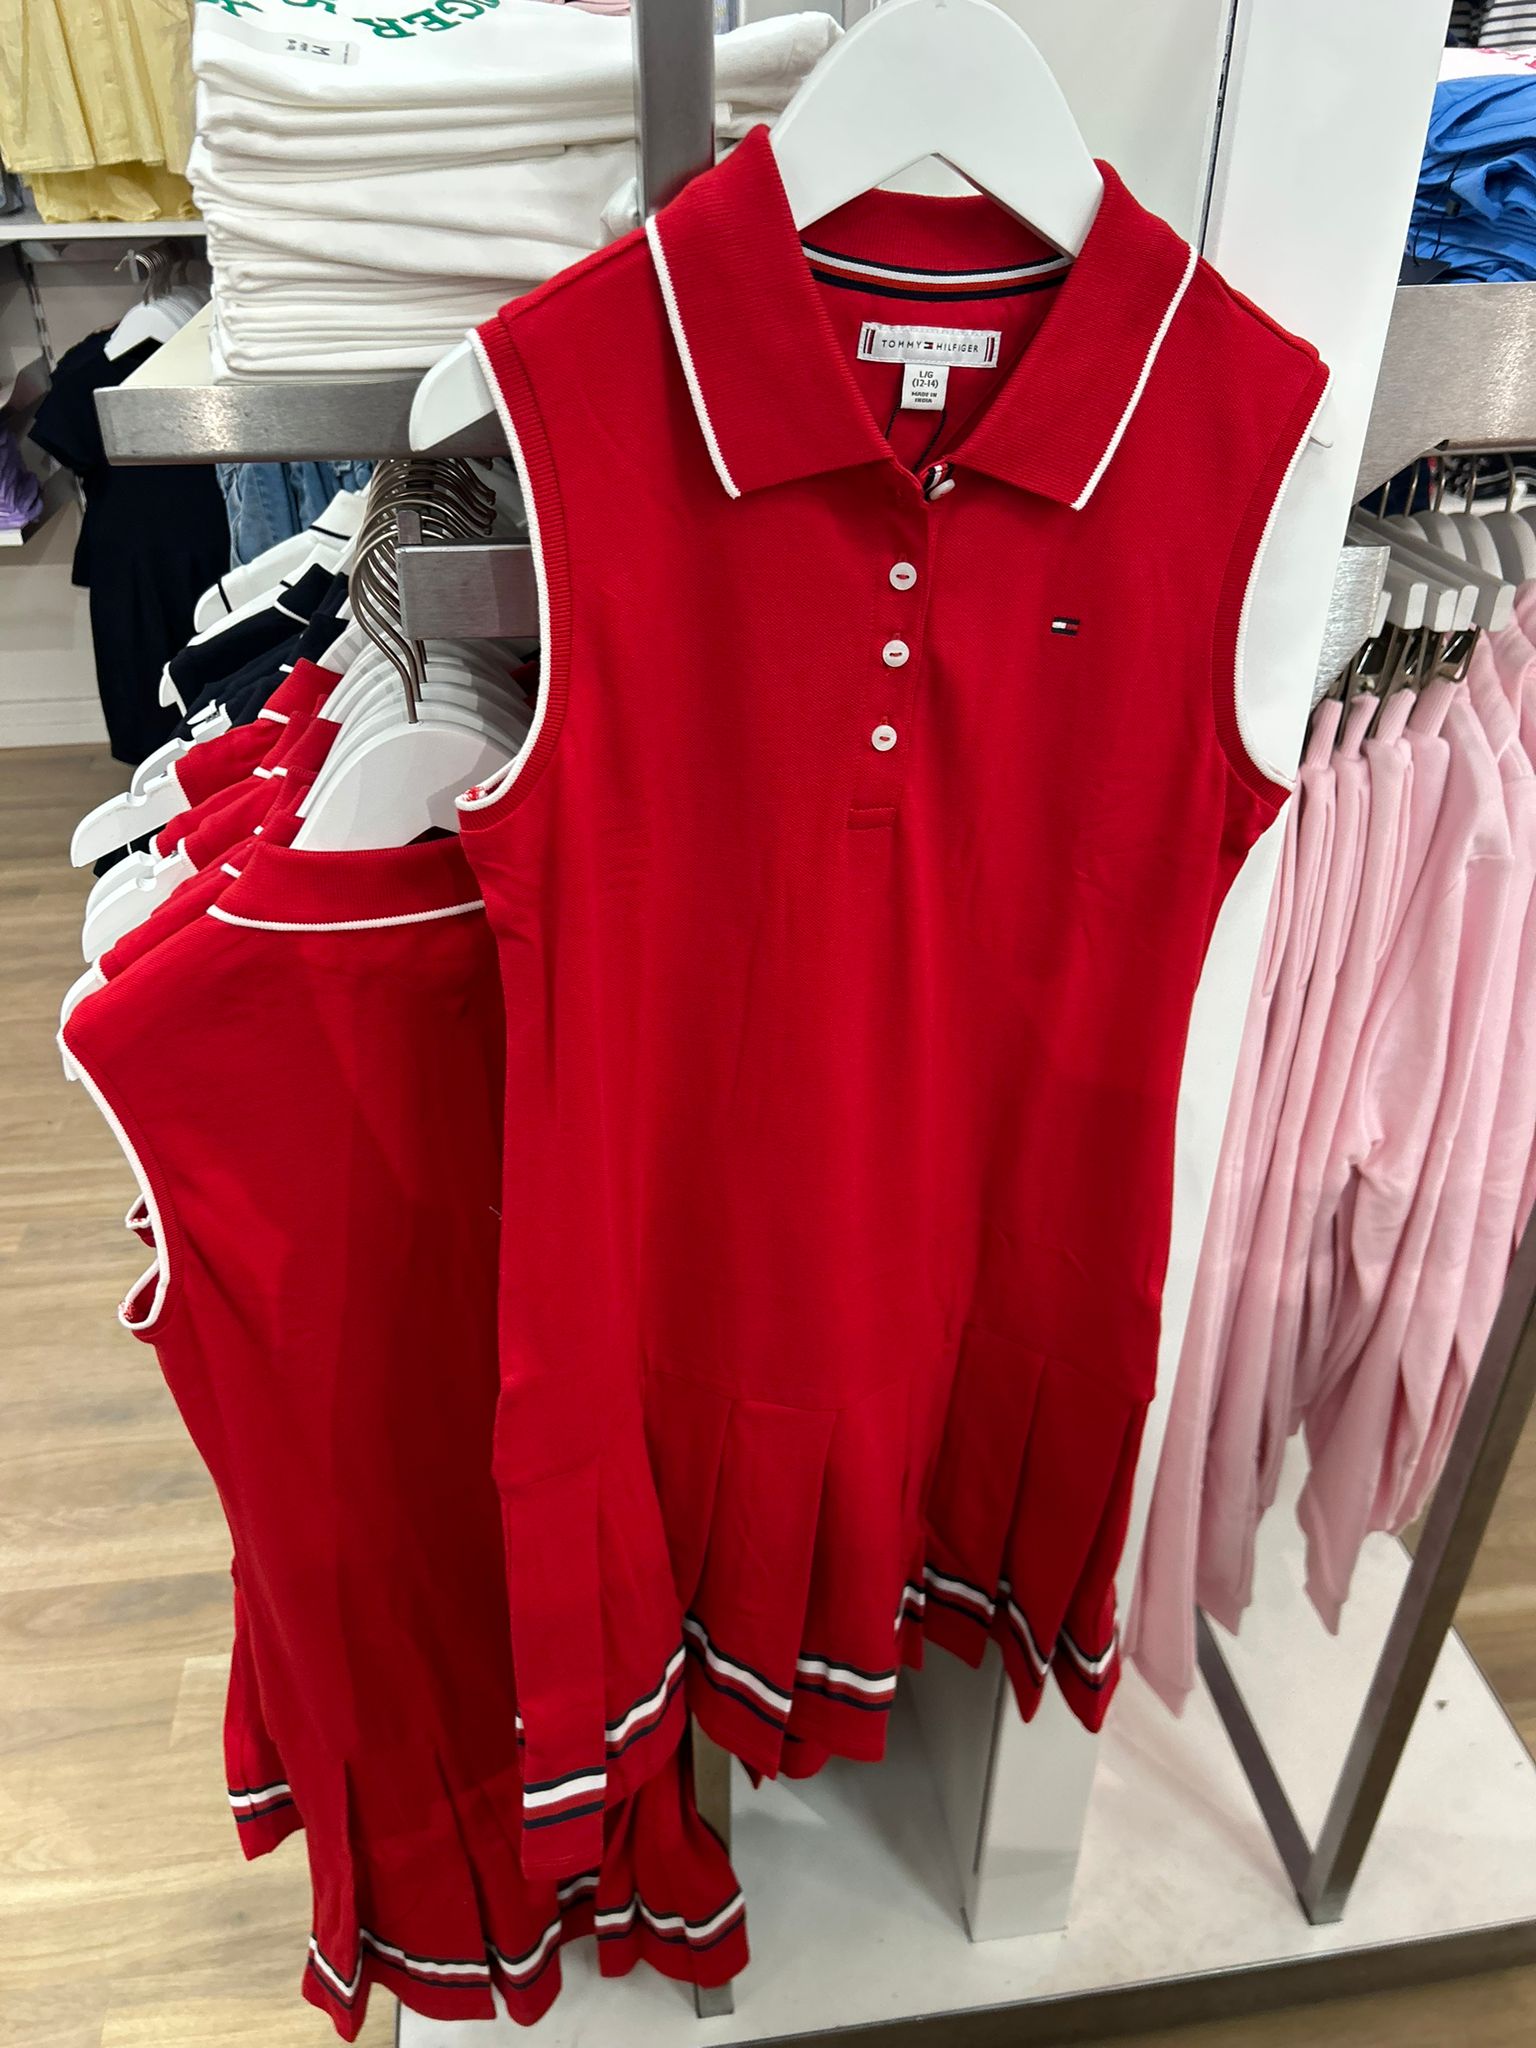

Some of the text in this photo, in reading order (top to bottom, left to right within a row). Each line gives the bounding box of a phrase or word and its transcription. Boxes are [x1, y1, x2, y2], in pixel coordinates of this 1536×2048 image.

[882, 339, 978, 352] TOMMY HILFIGER
[912, 379, 938, 388] (12-14)
